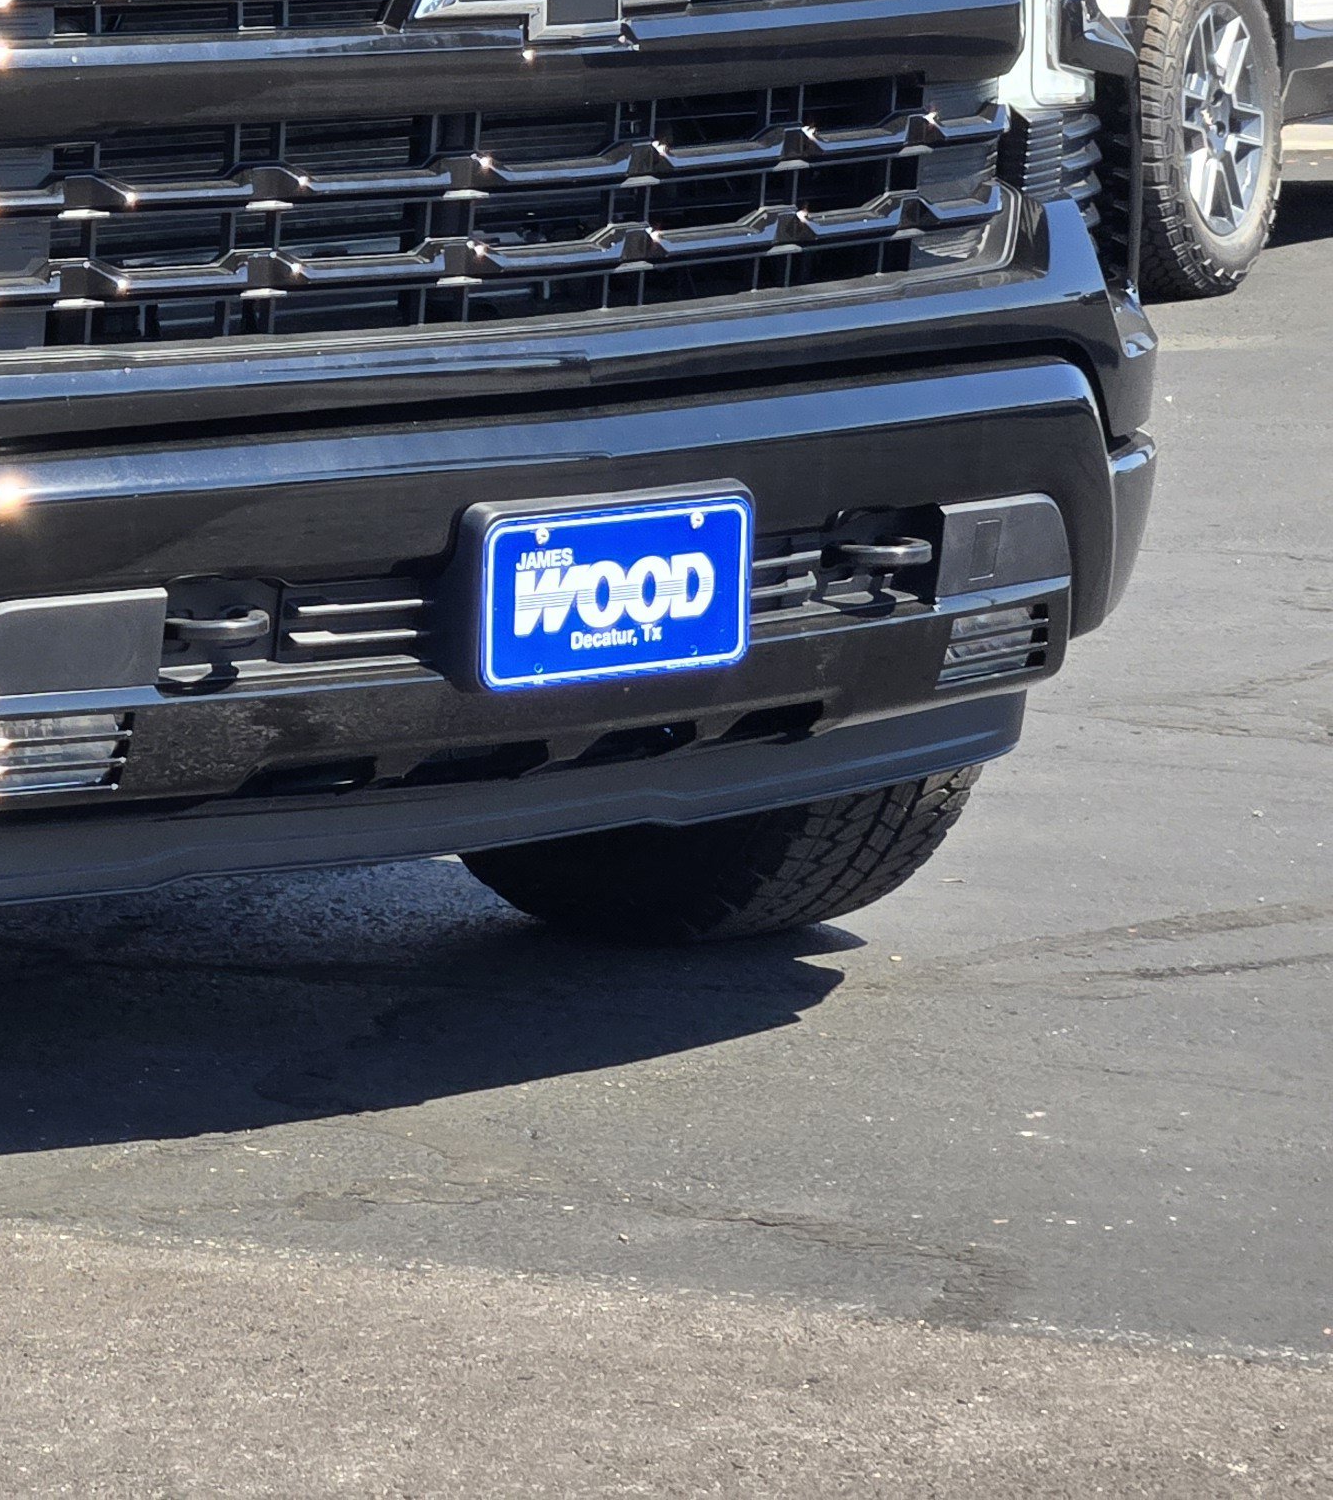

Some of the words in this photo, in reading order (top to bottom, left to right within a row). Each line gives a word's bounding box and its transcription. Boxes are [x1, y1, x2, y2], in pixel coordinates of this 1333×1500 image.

[515, 548, 573, 571] JAMES
[514, 552, 715, 636] WOOD
[570, 626, 638, 651] Decatur,
